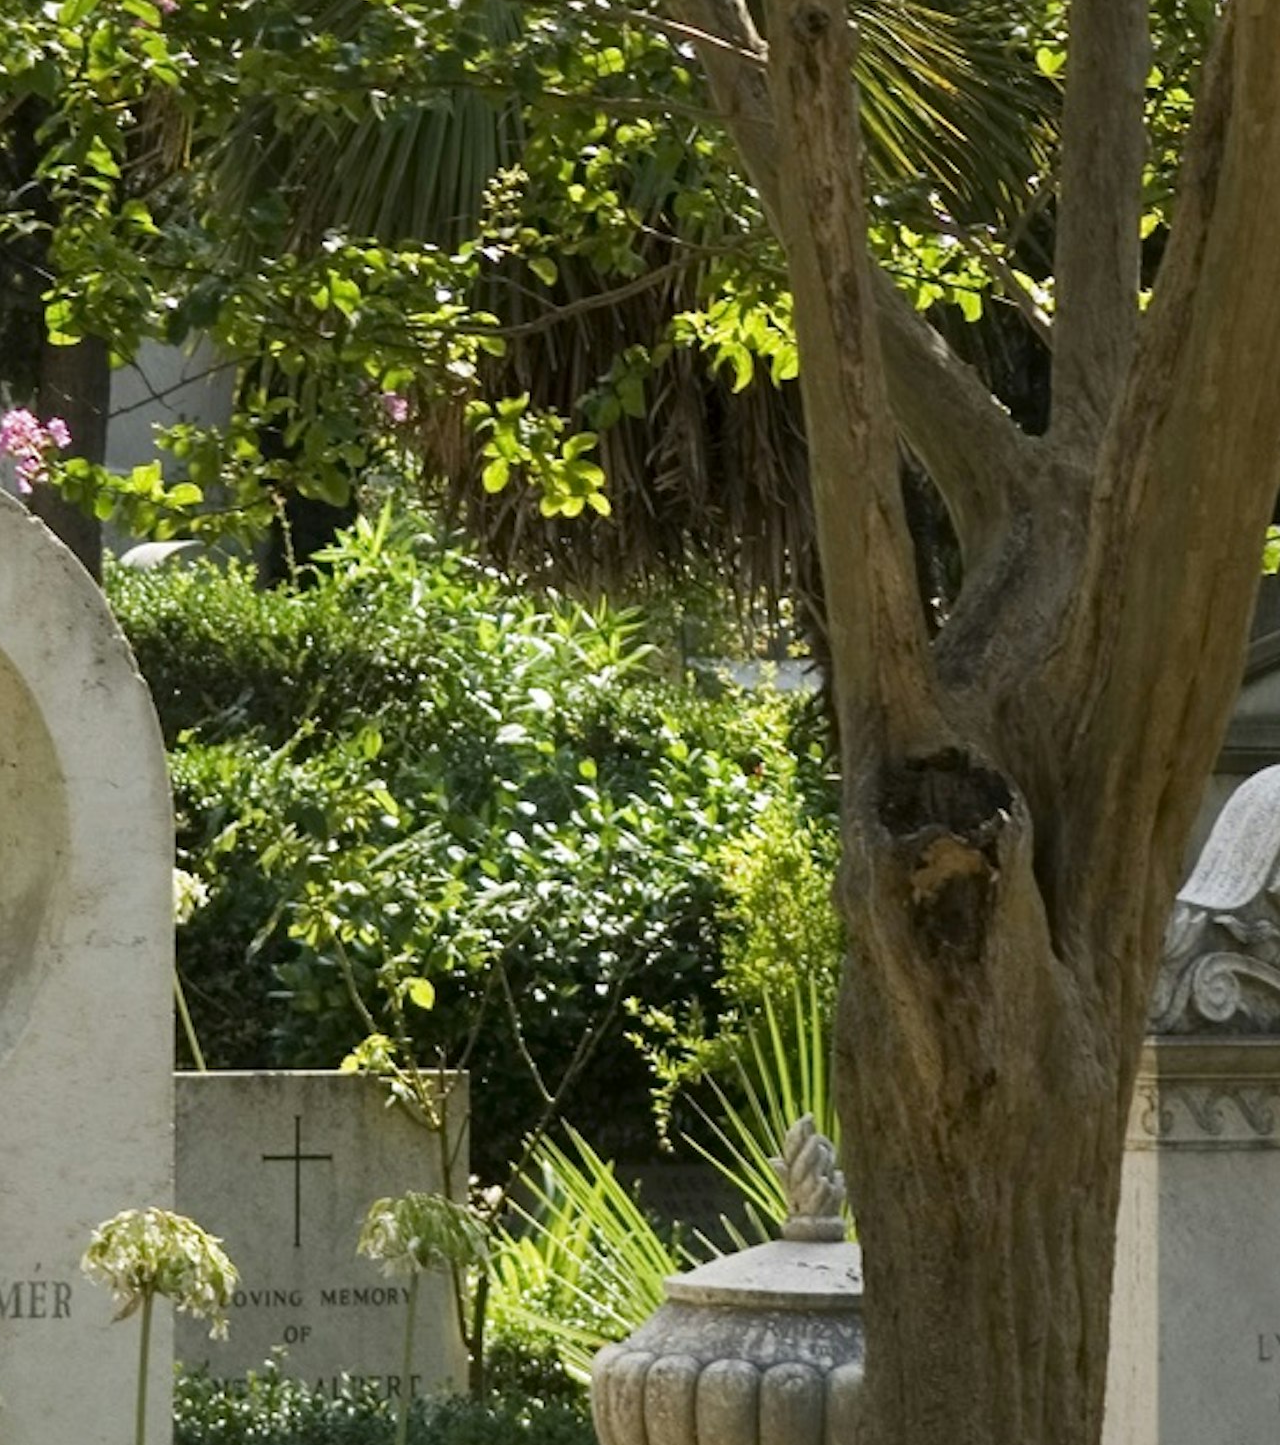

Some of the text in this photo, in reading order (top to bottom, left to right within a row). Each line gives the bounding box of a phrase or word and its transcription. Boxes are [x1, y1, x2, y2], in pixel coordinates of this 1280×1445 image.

[221, 1287, 412, 1308] OVING MEMORY
[282, 1325, 313, 1344] OF
